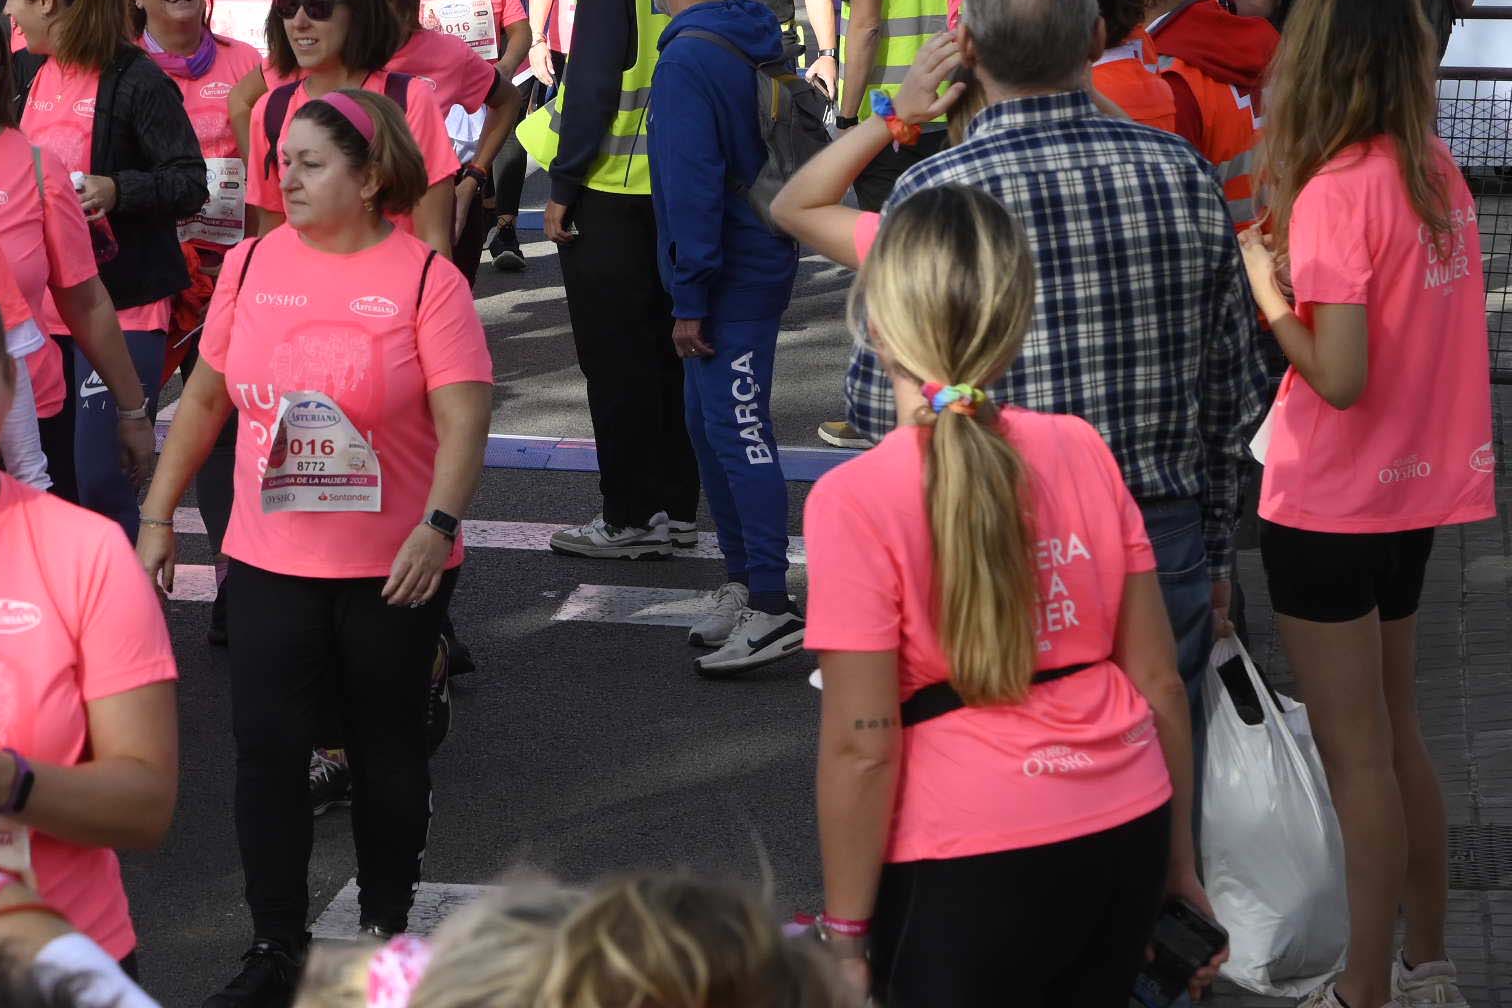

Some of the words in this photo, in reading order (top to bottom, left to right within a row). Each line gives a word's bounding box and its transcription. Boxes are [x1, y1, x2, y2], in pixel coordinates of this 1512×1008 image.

[446, 21, 471, 34] 016
[256, 292, 308, 308] OYSHO
[237, 383, 275, 410] TU
[730, 351, 773, 466] BARÇA
[293, 411, 337, 423] ASTURIANA
[290, 439, 335, 455] 016
[297, 461, 326, 472] 8772
[296, 476, 307, 484] DE
[308, 476, 320, 484] LA
[320, 476, 347, 484] MUJER
[328, 494, 371, 502] Santander
